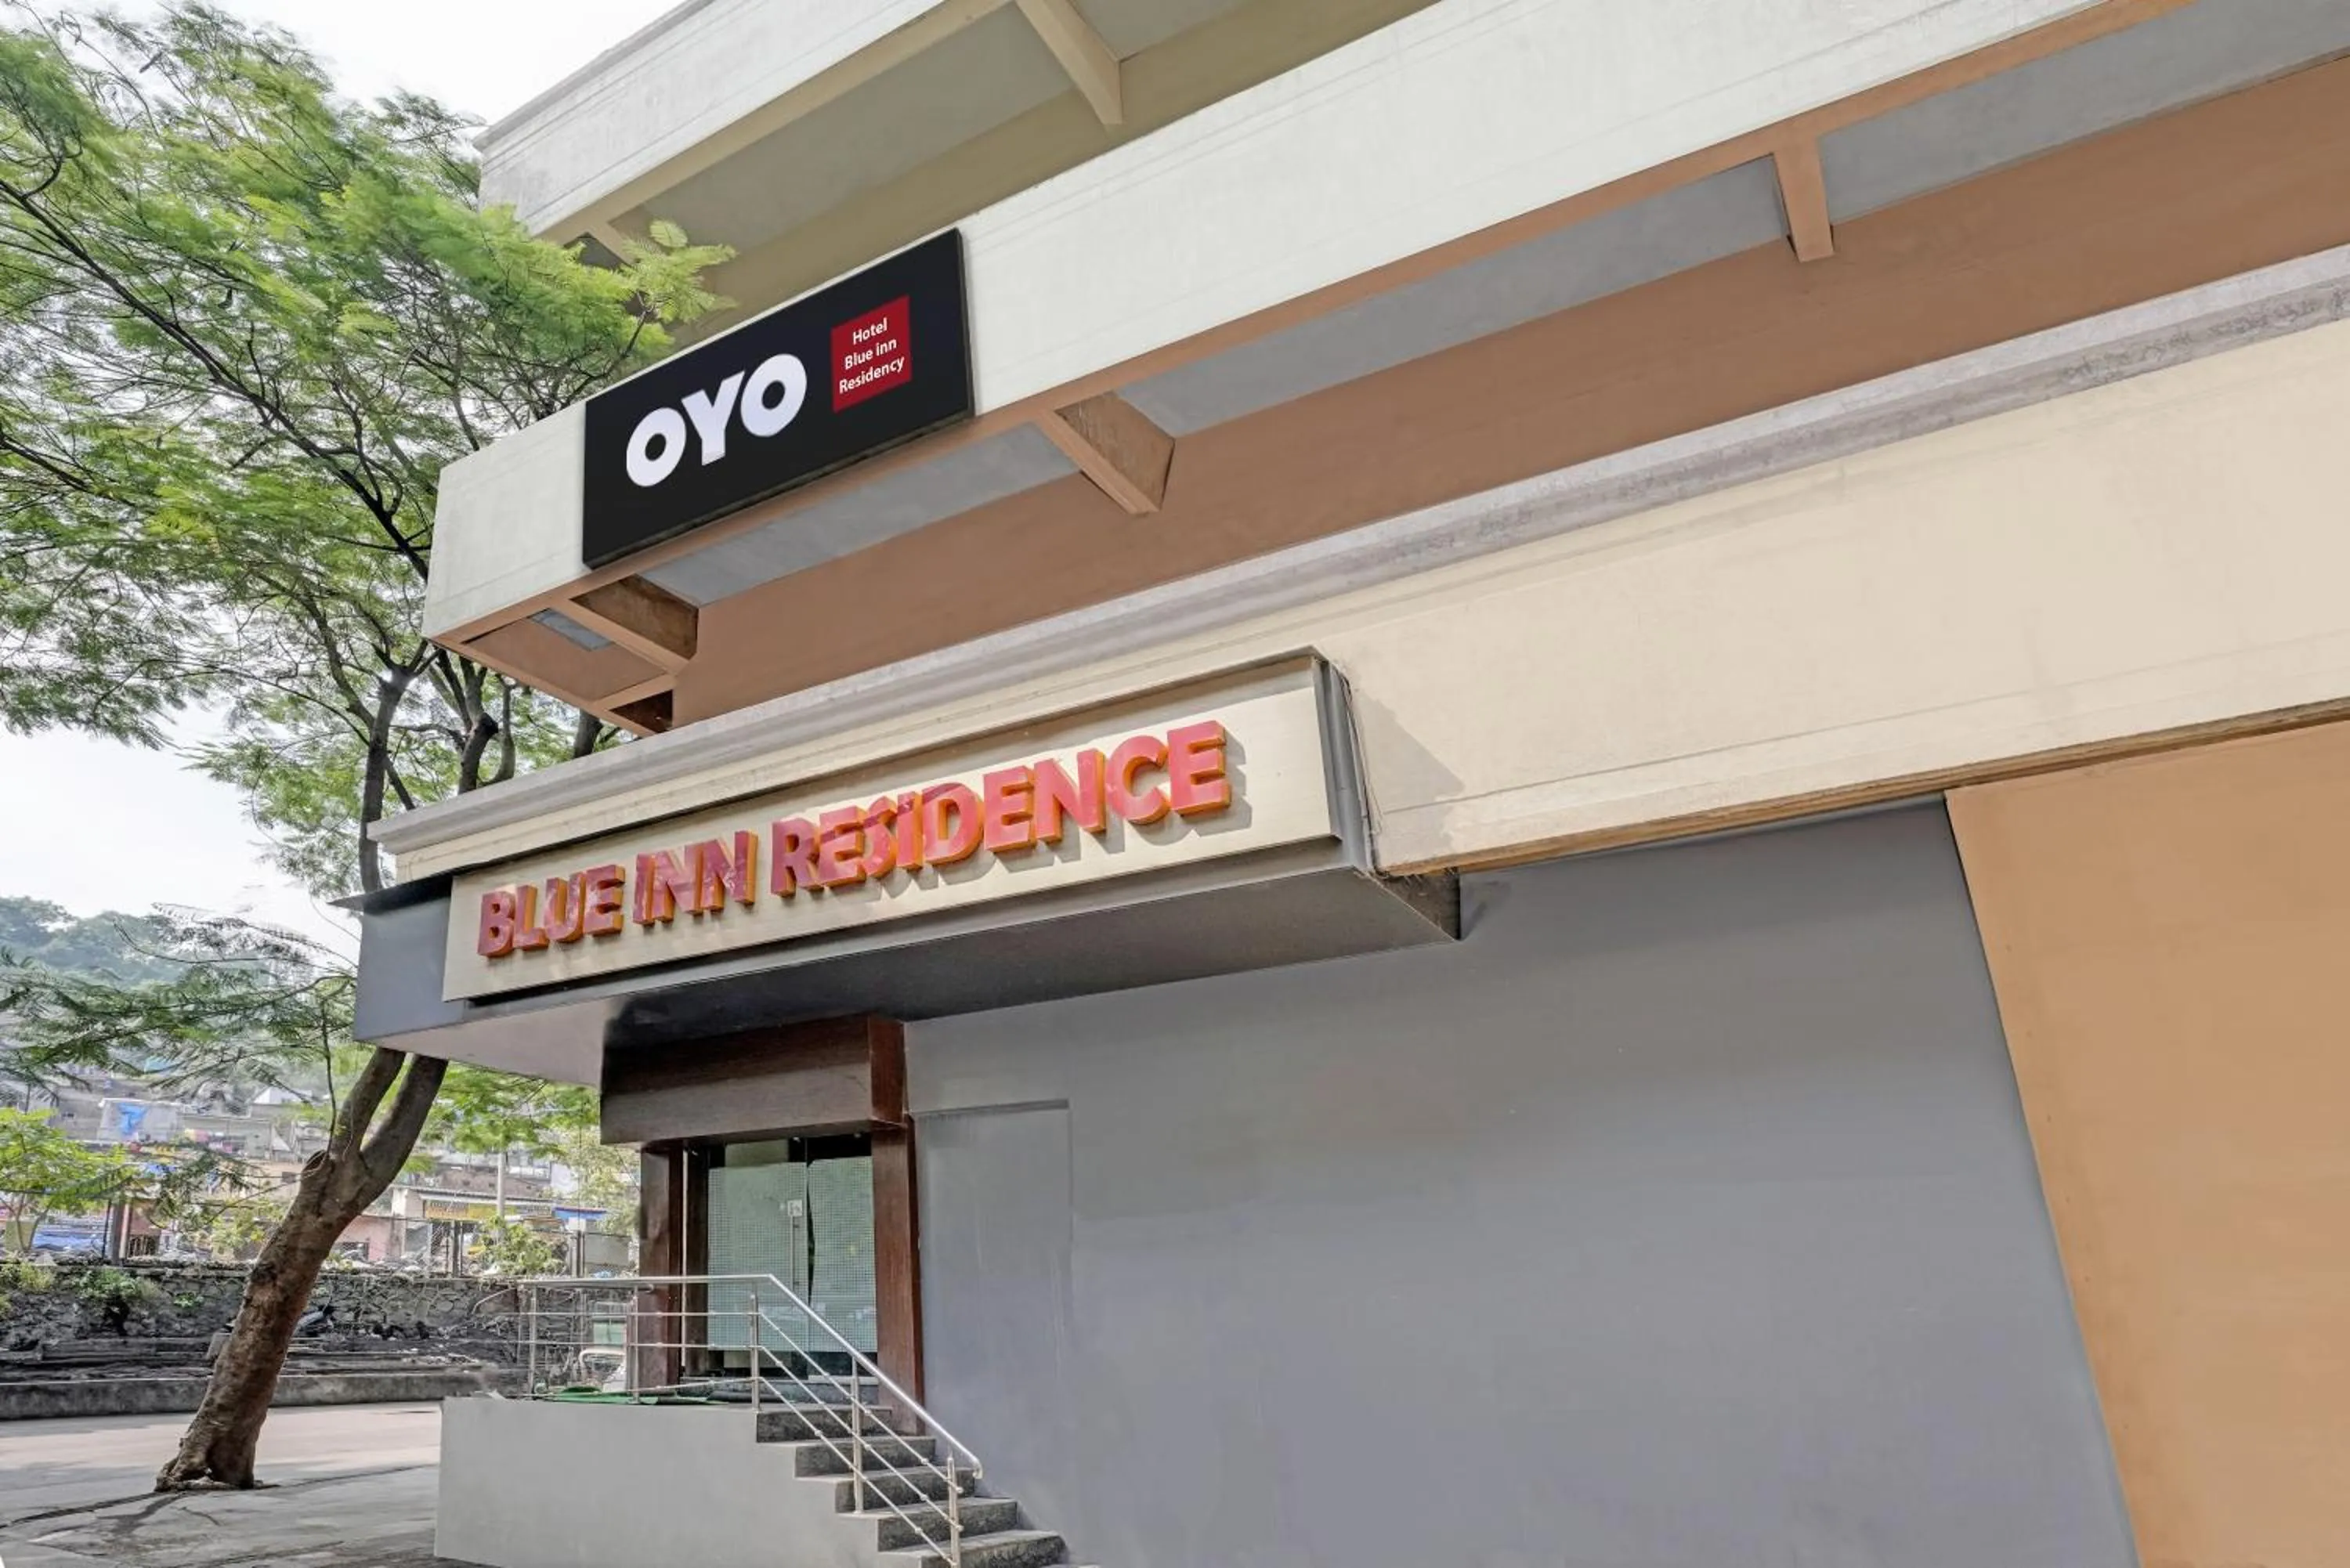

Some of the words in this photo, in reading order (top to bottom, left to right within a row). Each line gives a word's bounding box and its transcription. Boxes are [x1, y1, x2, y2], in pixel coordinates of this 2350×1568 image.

[852, 317, 888, 345] Hotel
[844, 349, 873, 370] Blue
[876, 338, 897, 356] inn
[839, 356, 905, 394] Residency
[627, 354, 807, 486] OYO
[478, 865, 625, 958] BLUE
[632, 830, 758, 926] INN
[771, 720, 1231, 898] RESIDENCE
